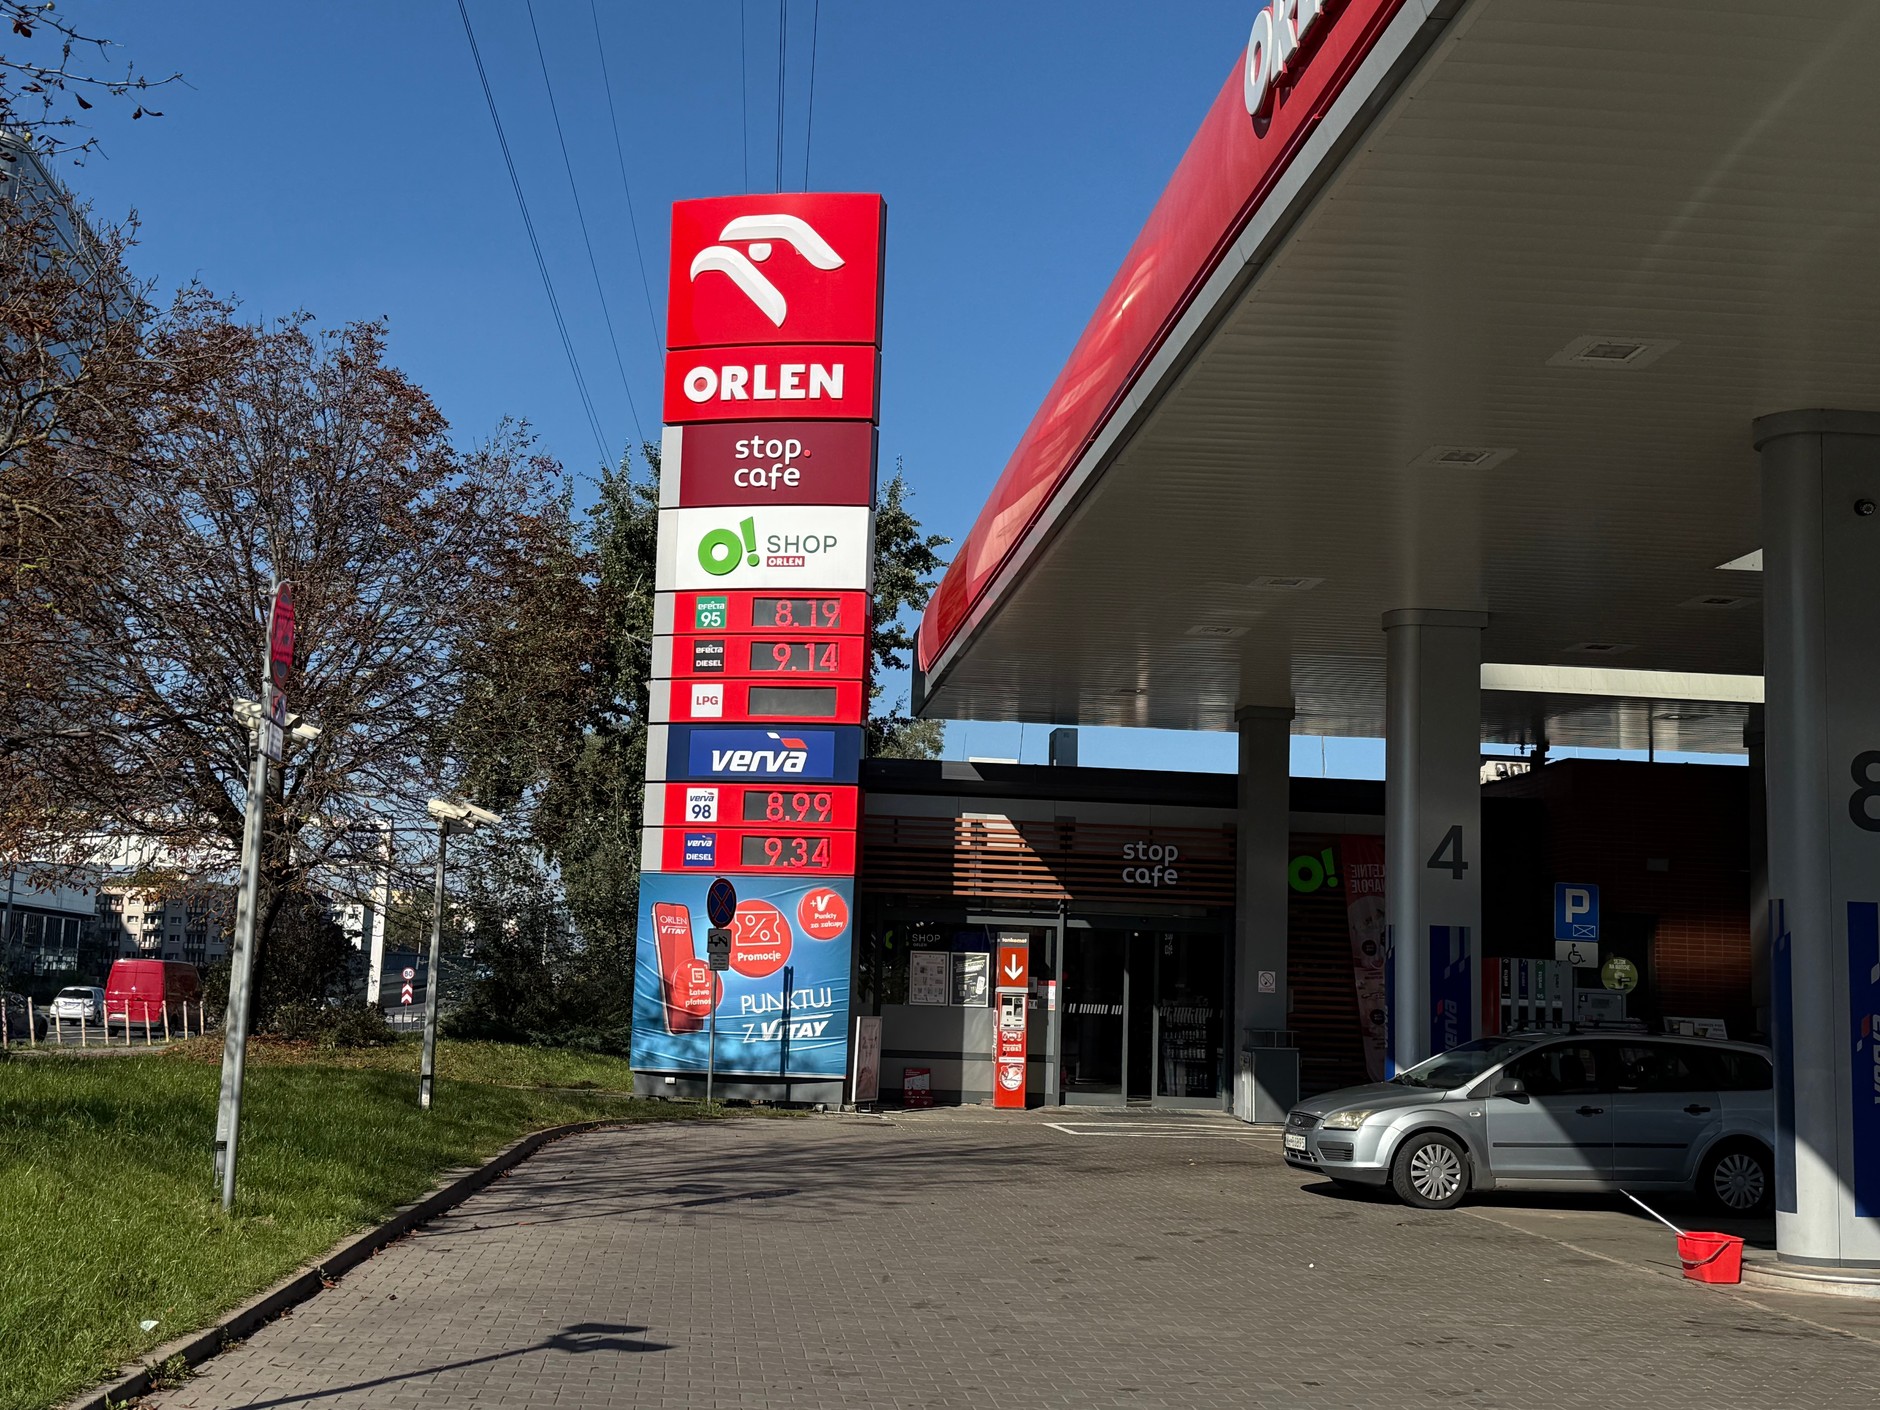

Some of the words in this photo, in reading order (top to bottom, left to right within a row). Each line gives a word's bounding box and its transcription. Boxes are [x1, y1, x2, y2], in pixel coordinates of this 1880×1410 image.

[683, 364, 844, 403] ORLEN
[734, 463, 800, 490] cafe
[697, 516, 760, 576] O!
[767, 534, 837, 554] SHOP
[768, 556, 803, 567] ORLEN
[701, 612, 721, 627] 95
[775, 599, 840, 627] 8.19
[772, 643, 837, 672] 9.14
[696, 696, 719, 706] LPG
[712, 750, 807, 773] verva
[1848, 750, 1880, 832] 8
[692, 804, 711, 819] 98
[766, 792, 832, 822] 8.99
[687, 839, 713, 847] verva
[764, 837, 829, 867] 9.34
[1123, 840, 1179, 867] stop
[1427, 825, 1469, 880] 4
[686, 853, 713, 861] DIESEL
[1288, 847, 1339, 893] O!
[1122, 865, 1178, 887] cafe
[814, 912, 837, 920] Punkty
[1565, 888, 1590, 923] P
[659, 915, 688, 925] ORLEN
[661, 925, 688, 935] VITAY
[912, 933, 941, 943] SHOP
[737, 950, 782, 962] Promocje
[741, 987, 833, 1015] PUNKTUJ
[761, 1013, 834, 1042] VITAY
